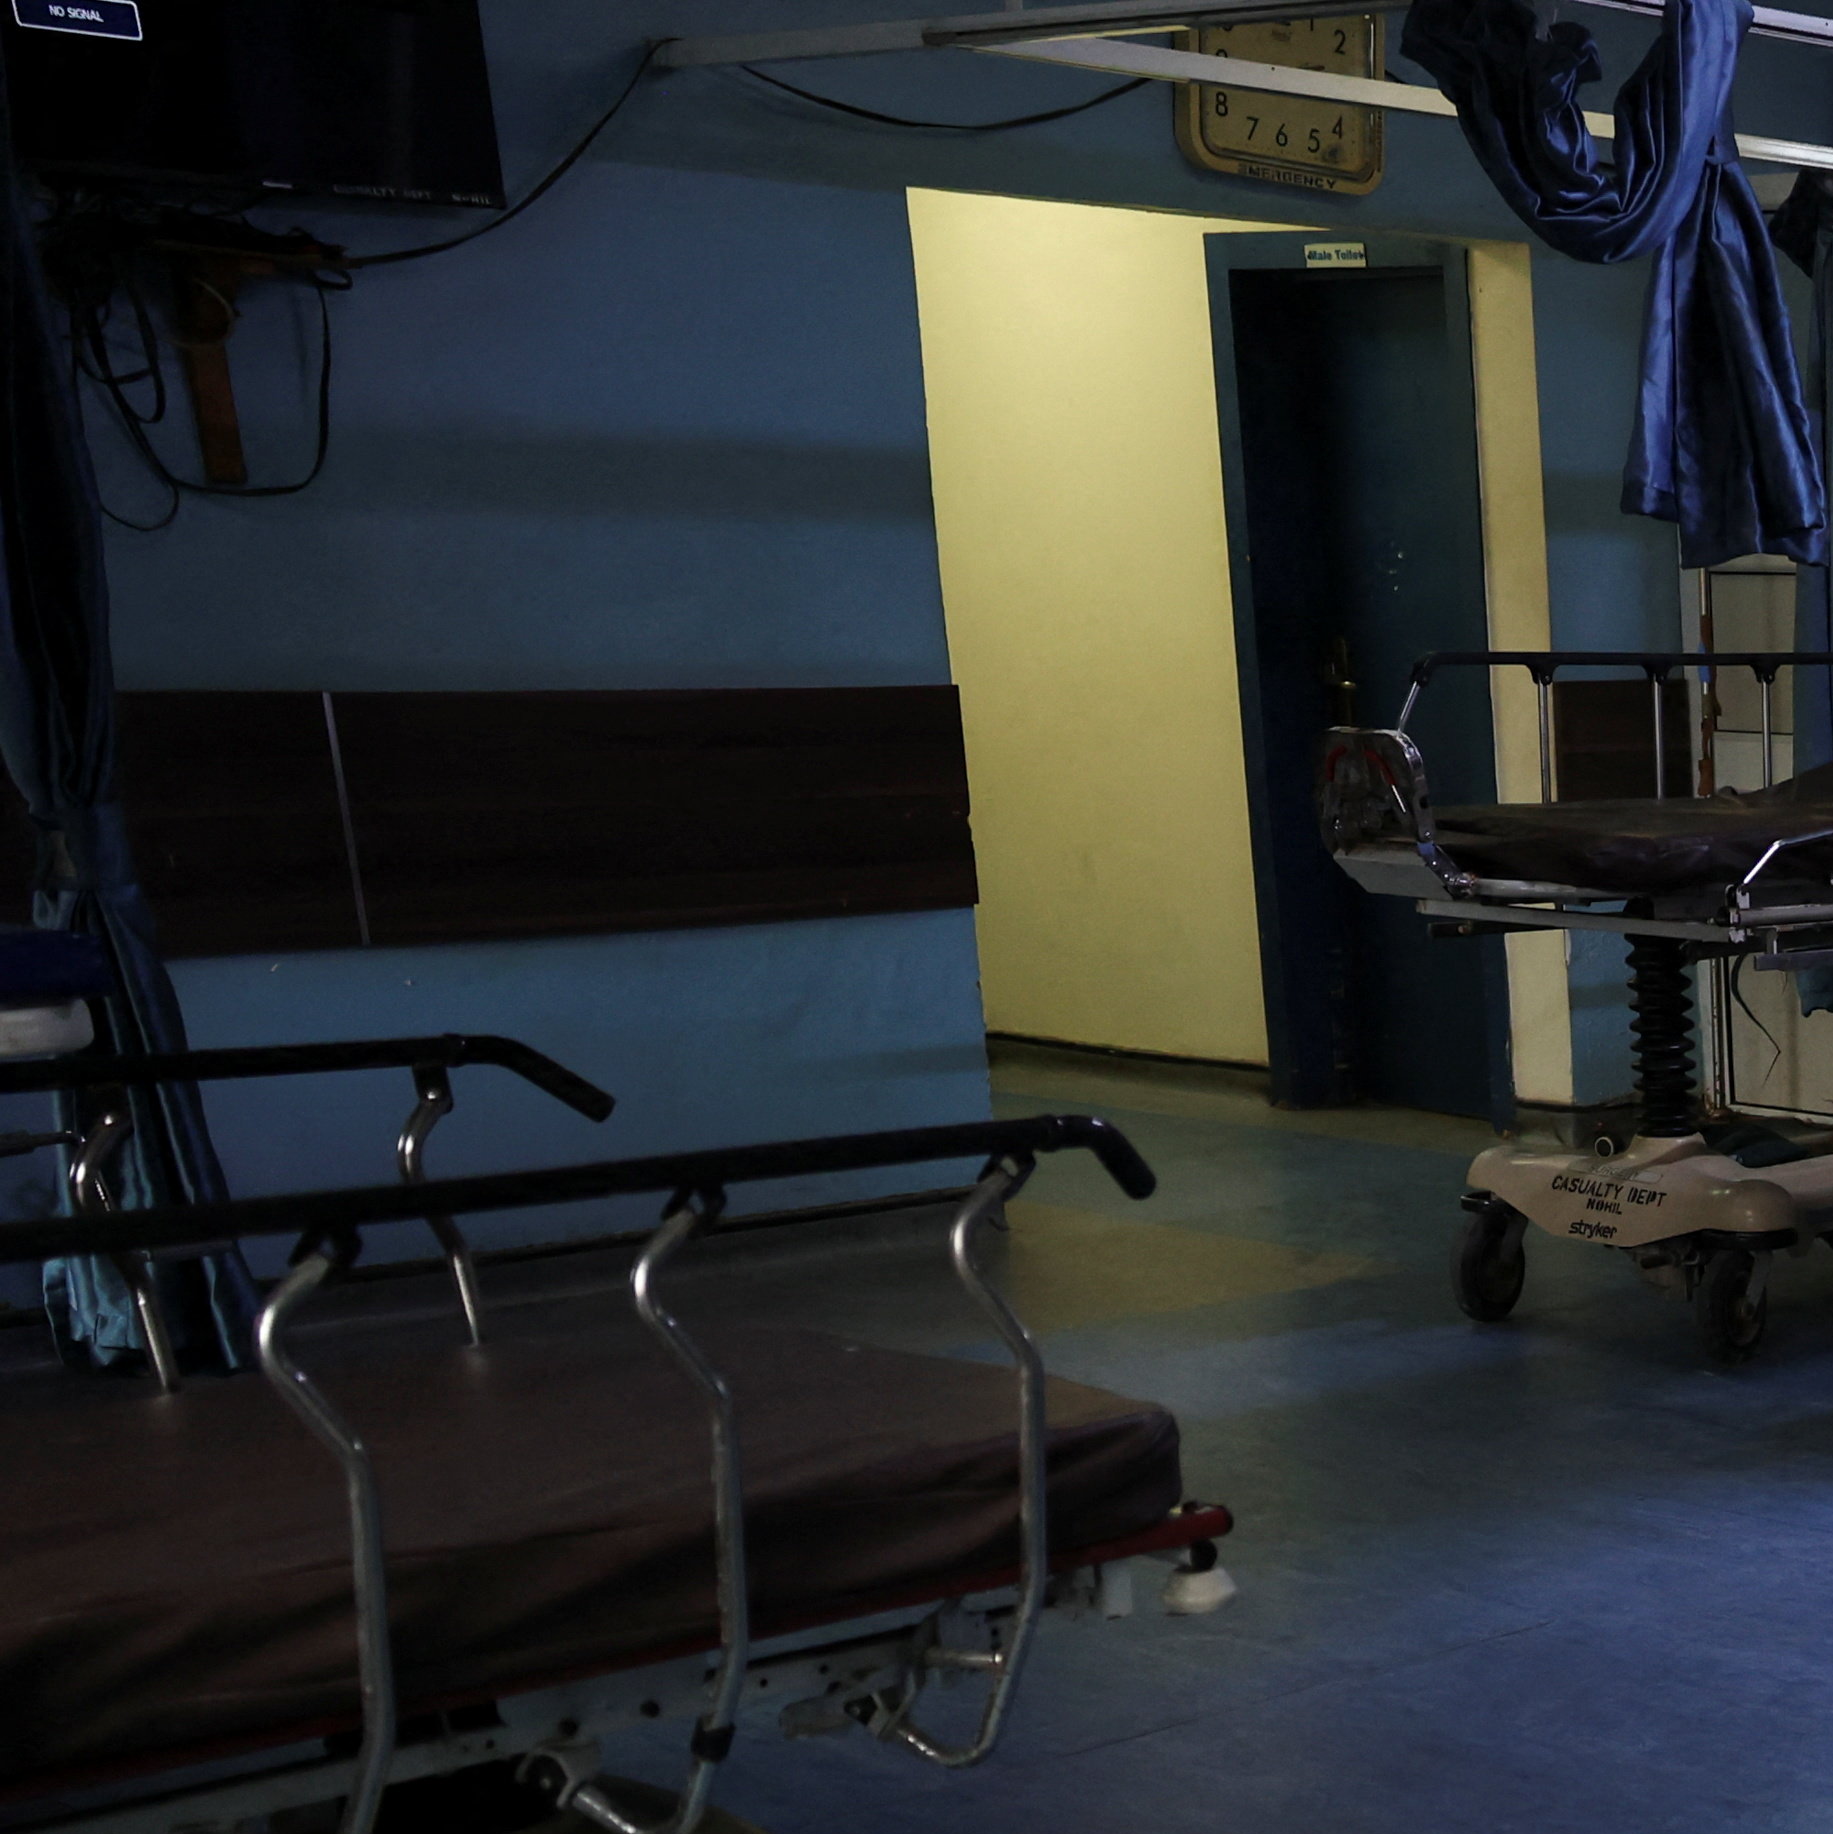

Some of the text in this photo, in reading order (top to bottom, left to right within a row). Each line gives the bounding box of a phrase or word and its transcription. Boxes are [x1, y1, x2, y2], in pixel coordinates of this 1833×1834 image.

[48, 4, 104, 23] NO SIGNAL
[1334, 29, 1346, 55] 2
[1215, 91, 1228, 117] 8
[1246, 116, 1259, 141] 7
[1275, 123, 1288, 147] 6
[1331, 115, 1343, 140] 4
[1307, 129, 1320, 153] 5
[1239, 162, 1336, 189] EMERGENCY
[1552, 1175, 1667, 1207] CASUALTY DEPT
[1586, 1198, 1622, 1215] NOHIL
[1568, 1219, 1618, 1239] stryker
